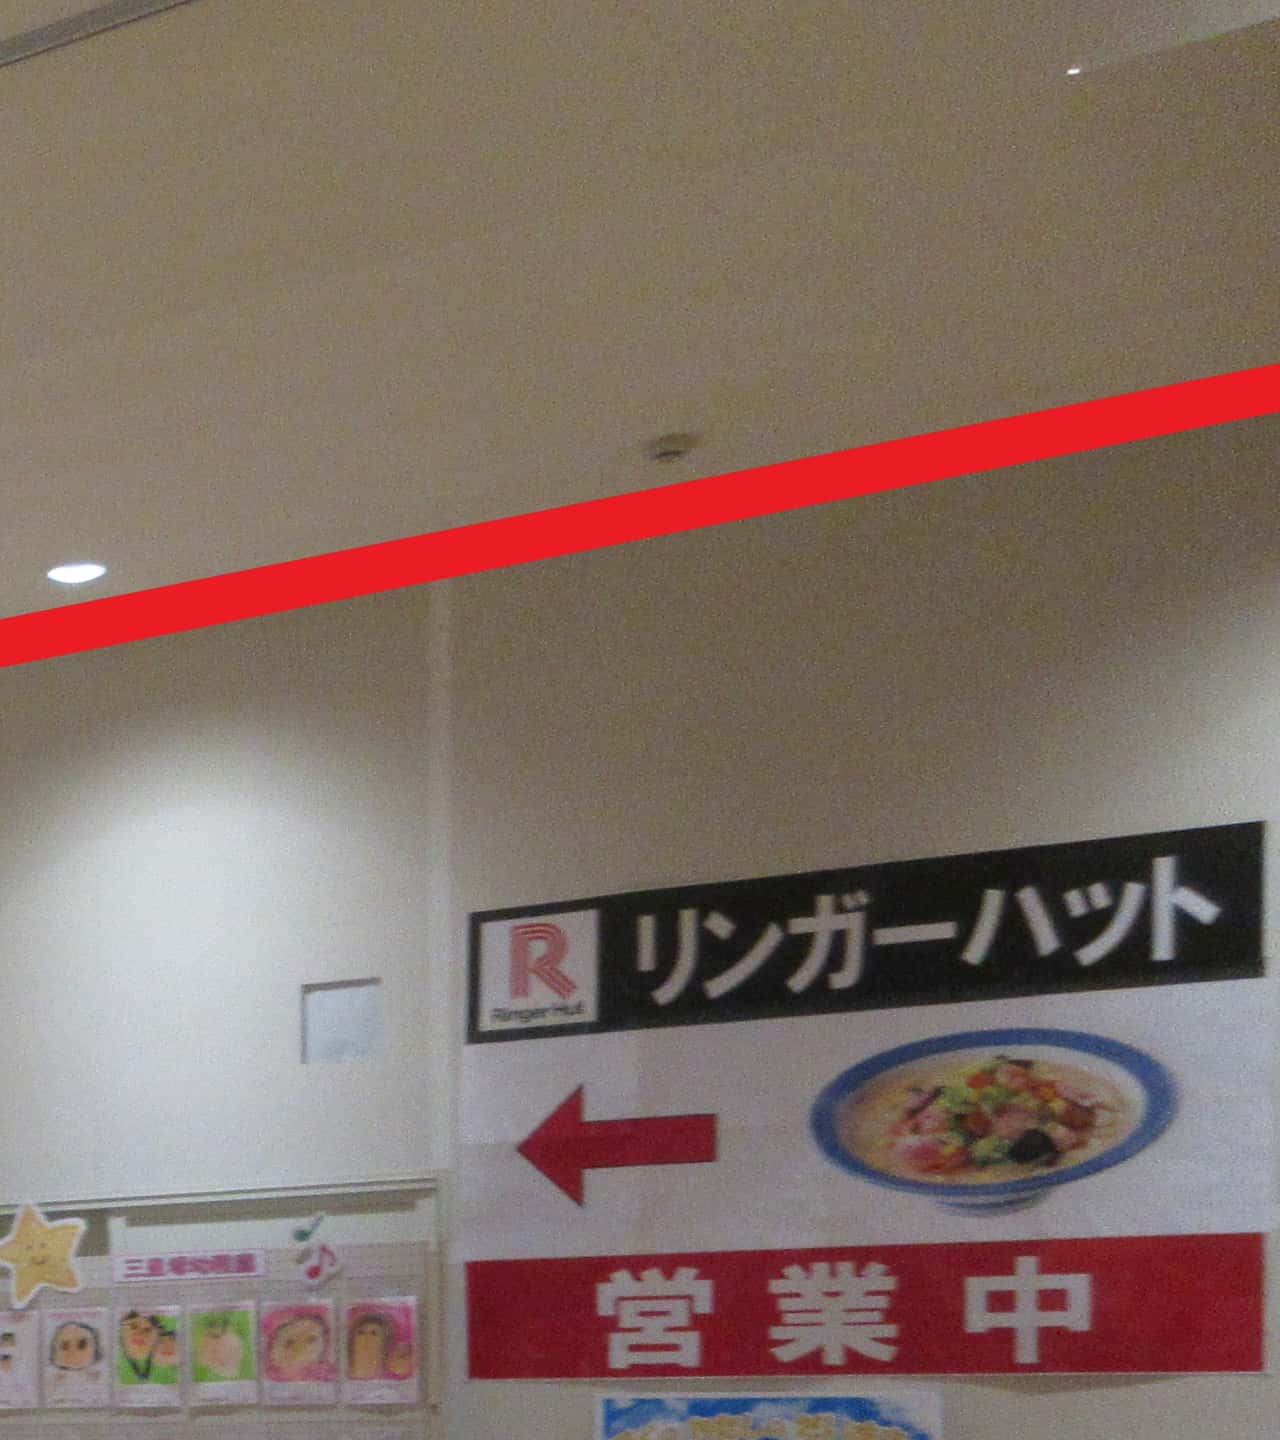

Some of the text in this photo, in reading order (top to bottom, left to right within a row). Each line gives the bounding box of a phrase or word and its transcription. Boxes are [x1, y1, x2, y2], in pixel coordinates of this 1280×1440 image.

[635, 856, 1223, 1007] リンガーハット
[595, 1257, 1093, 1371] 営業中
